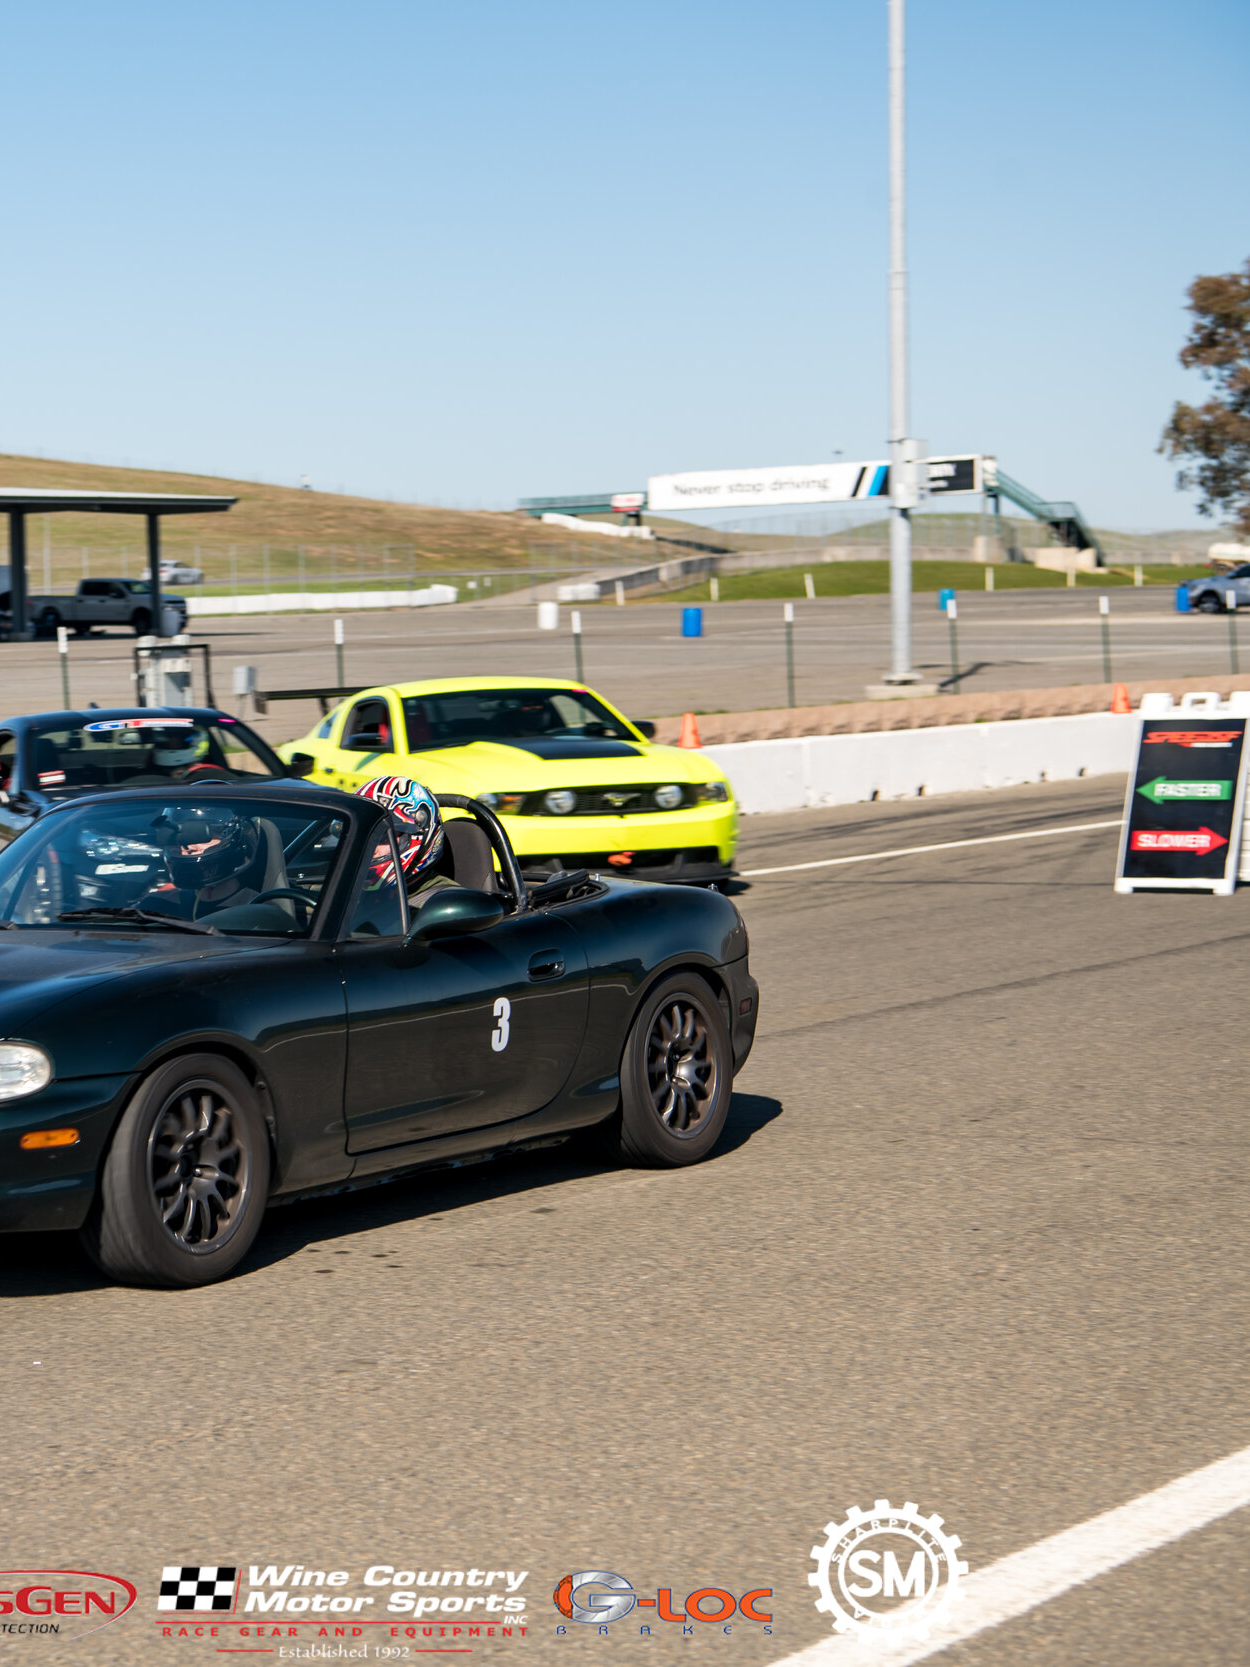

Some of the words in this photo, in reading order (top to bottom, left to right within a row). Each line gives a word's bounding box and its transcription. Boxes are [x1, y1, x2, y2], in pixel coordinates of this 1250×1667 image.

[1154, 783, 1222, 797] FASTER
[1137, 833, 1211, 848] SLOWER
[491, 996, 511, 1053] 3
